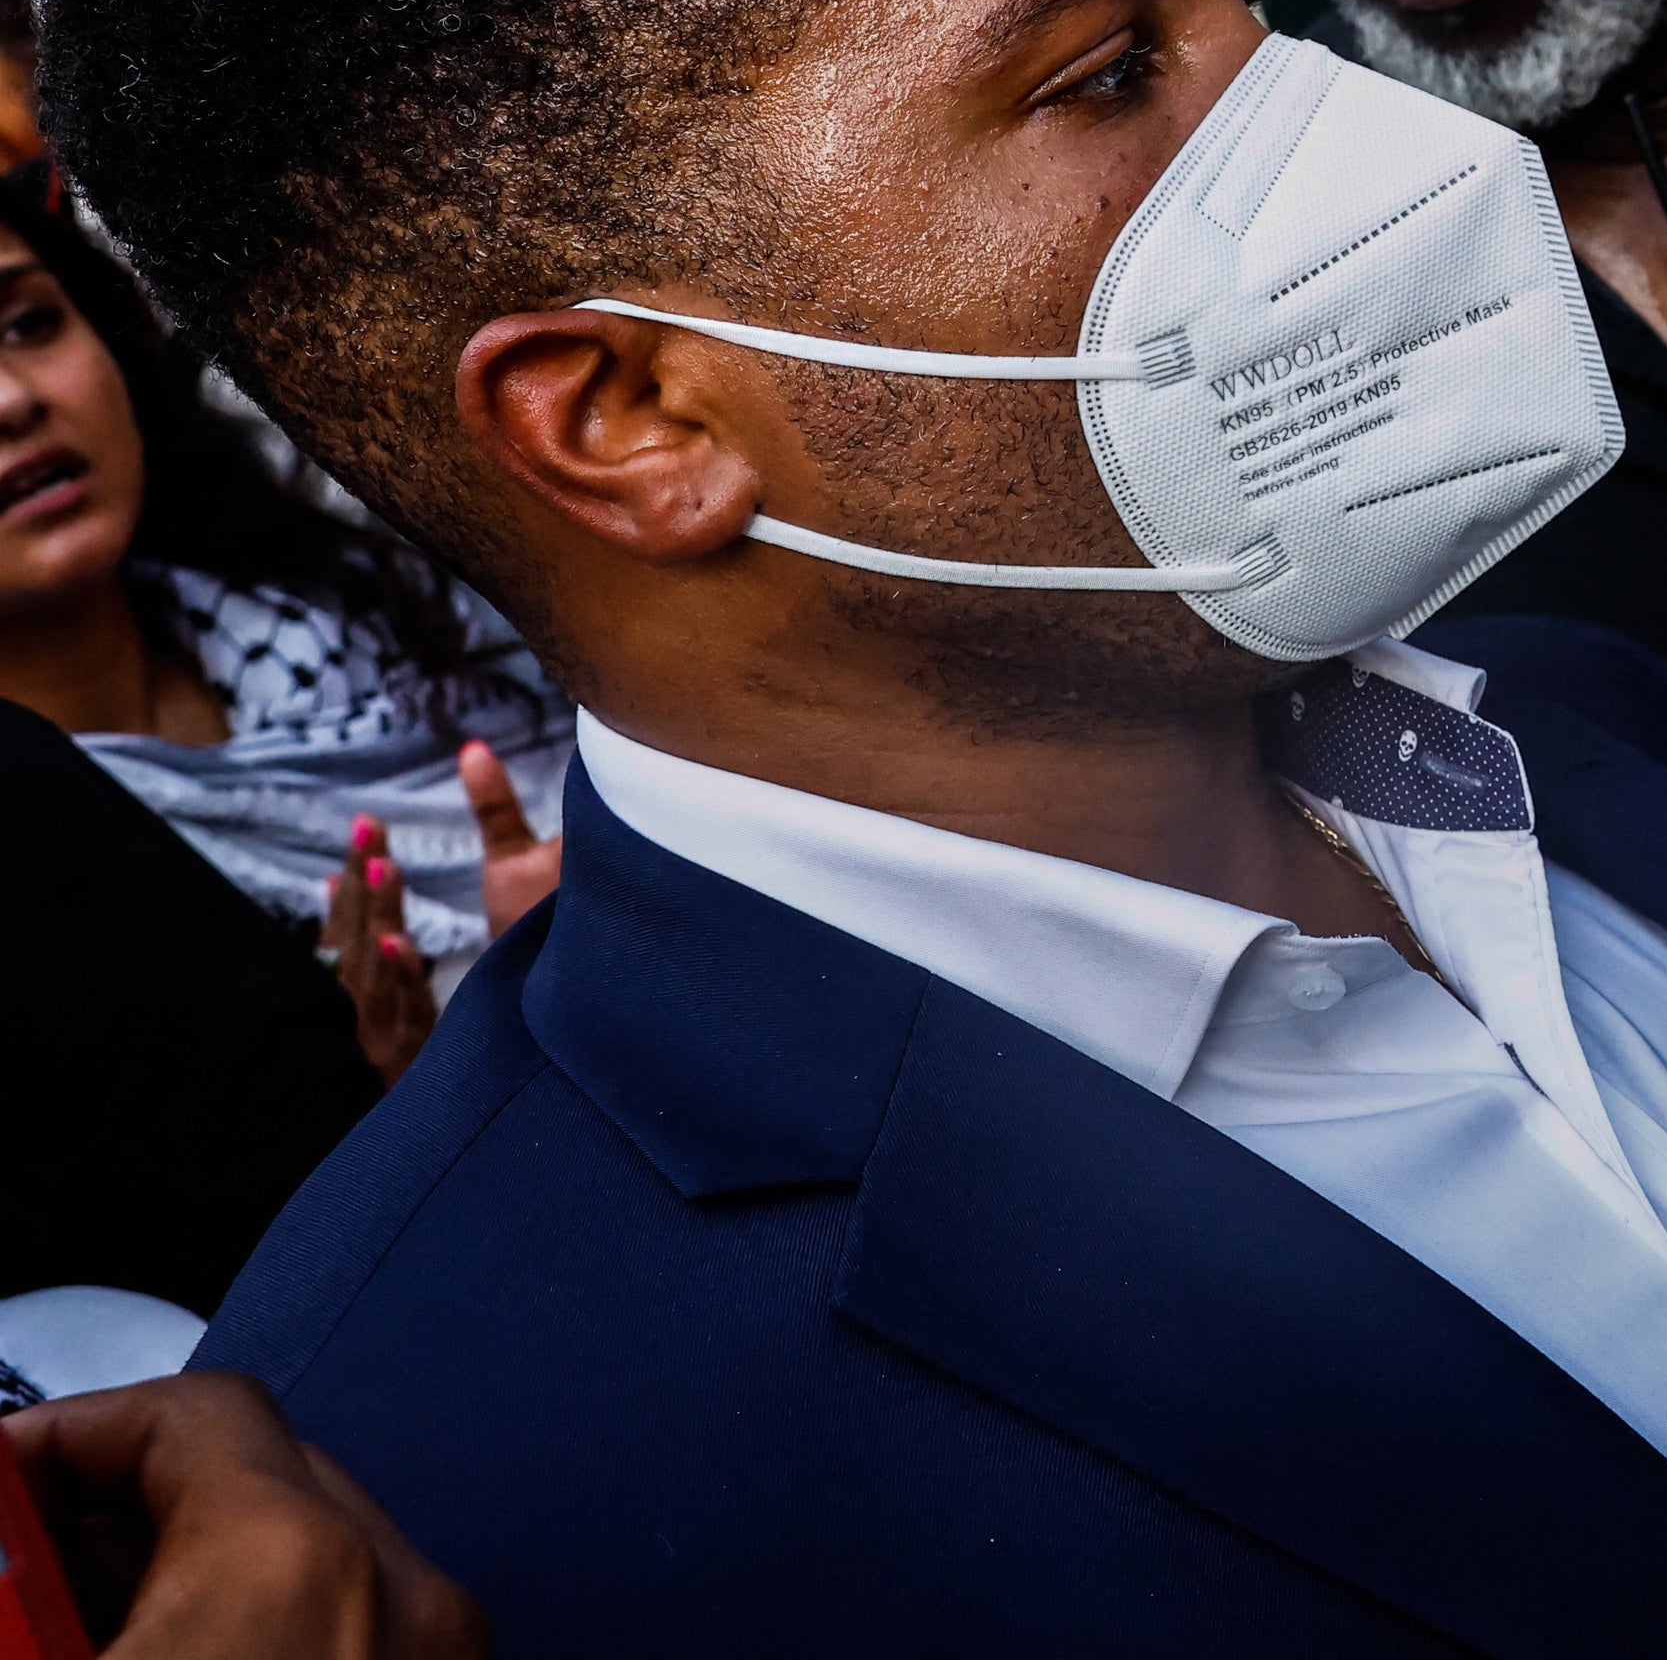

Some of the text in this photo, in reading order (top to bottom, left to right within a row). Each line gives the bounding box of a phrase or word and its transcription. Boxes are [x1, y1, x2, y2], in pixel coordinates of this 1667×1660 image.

[1207, 327, 1357, 402] WWDOLL
[1220, 401, 1274, 434] KN95
[1370, 320, 1462, 369] Protective
[1465, 295, 1515, 327] Mask
[1229, 375, 1401, 462] GB2626-2019 KN95
[1239, 414, 1395, 488] See user instructions
[1244, 456, 1340, 502] before using
